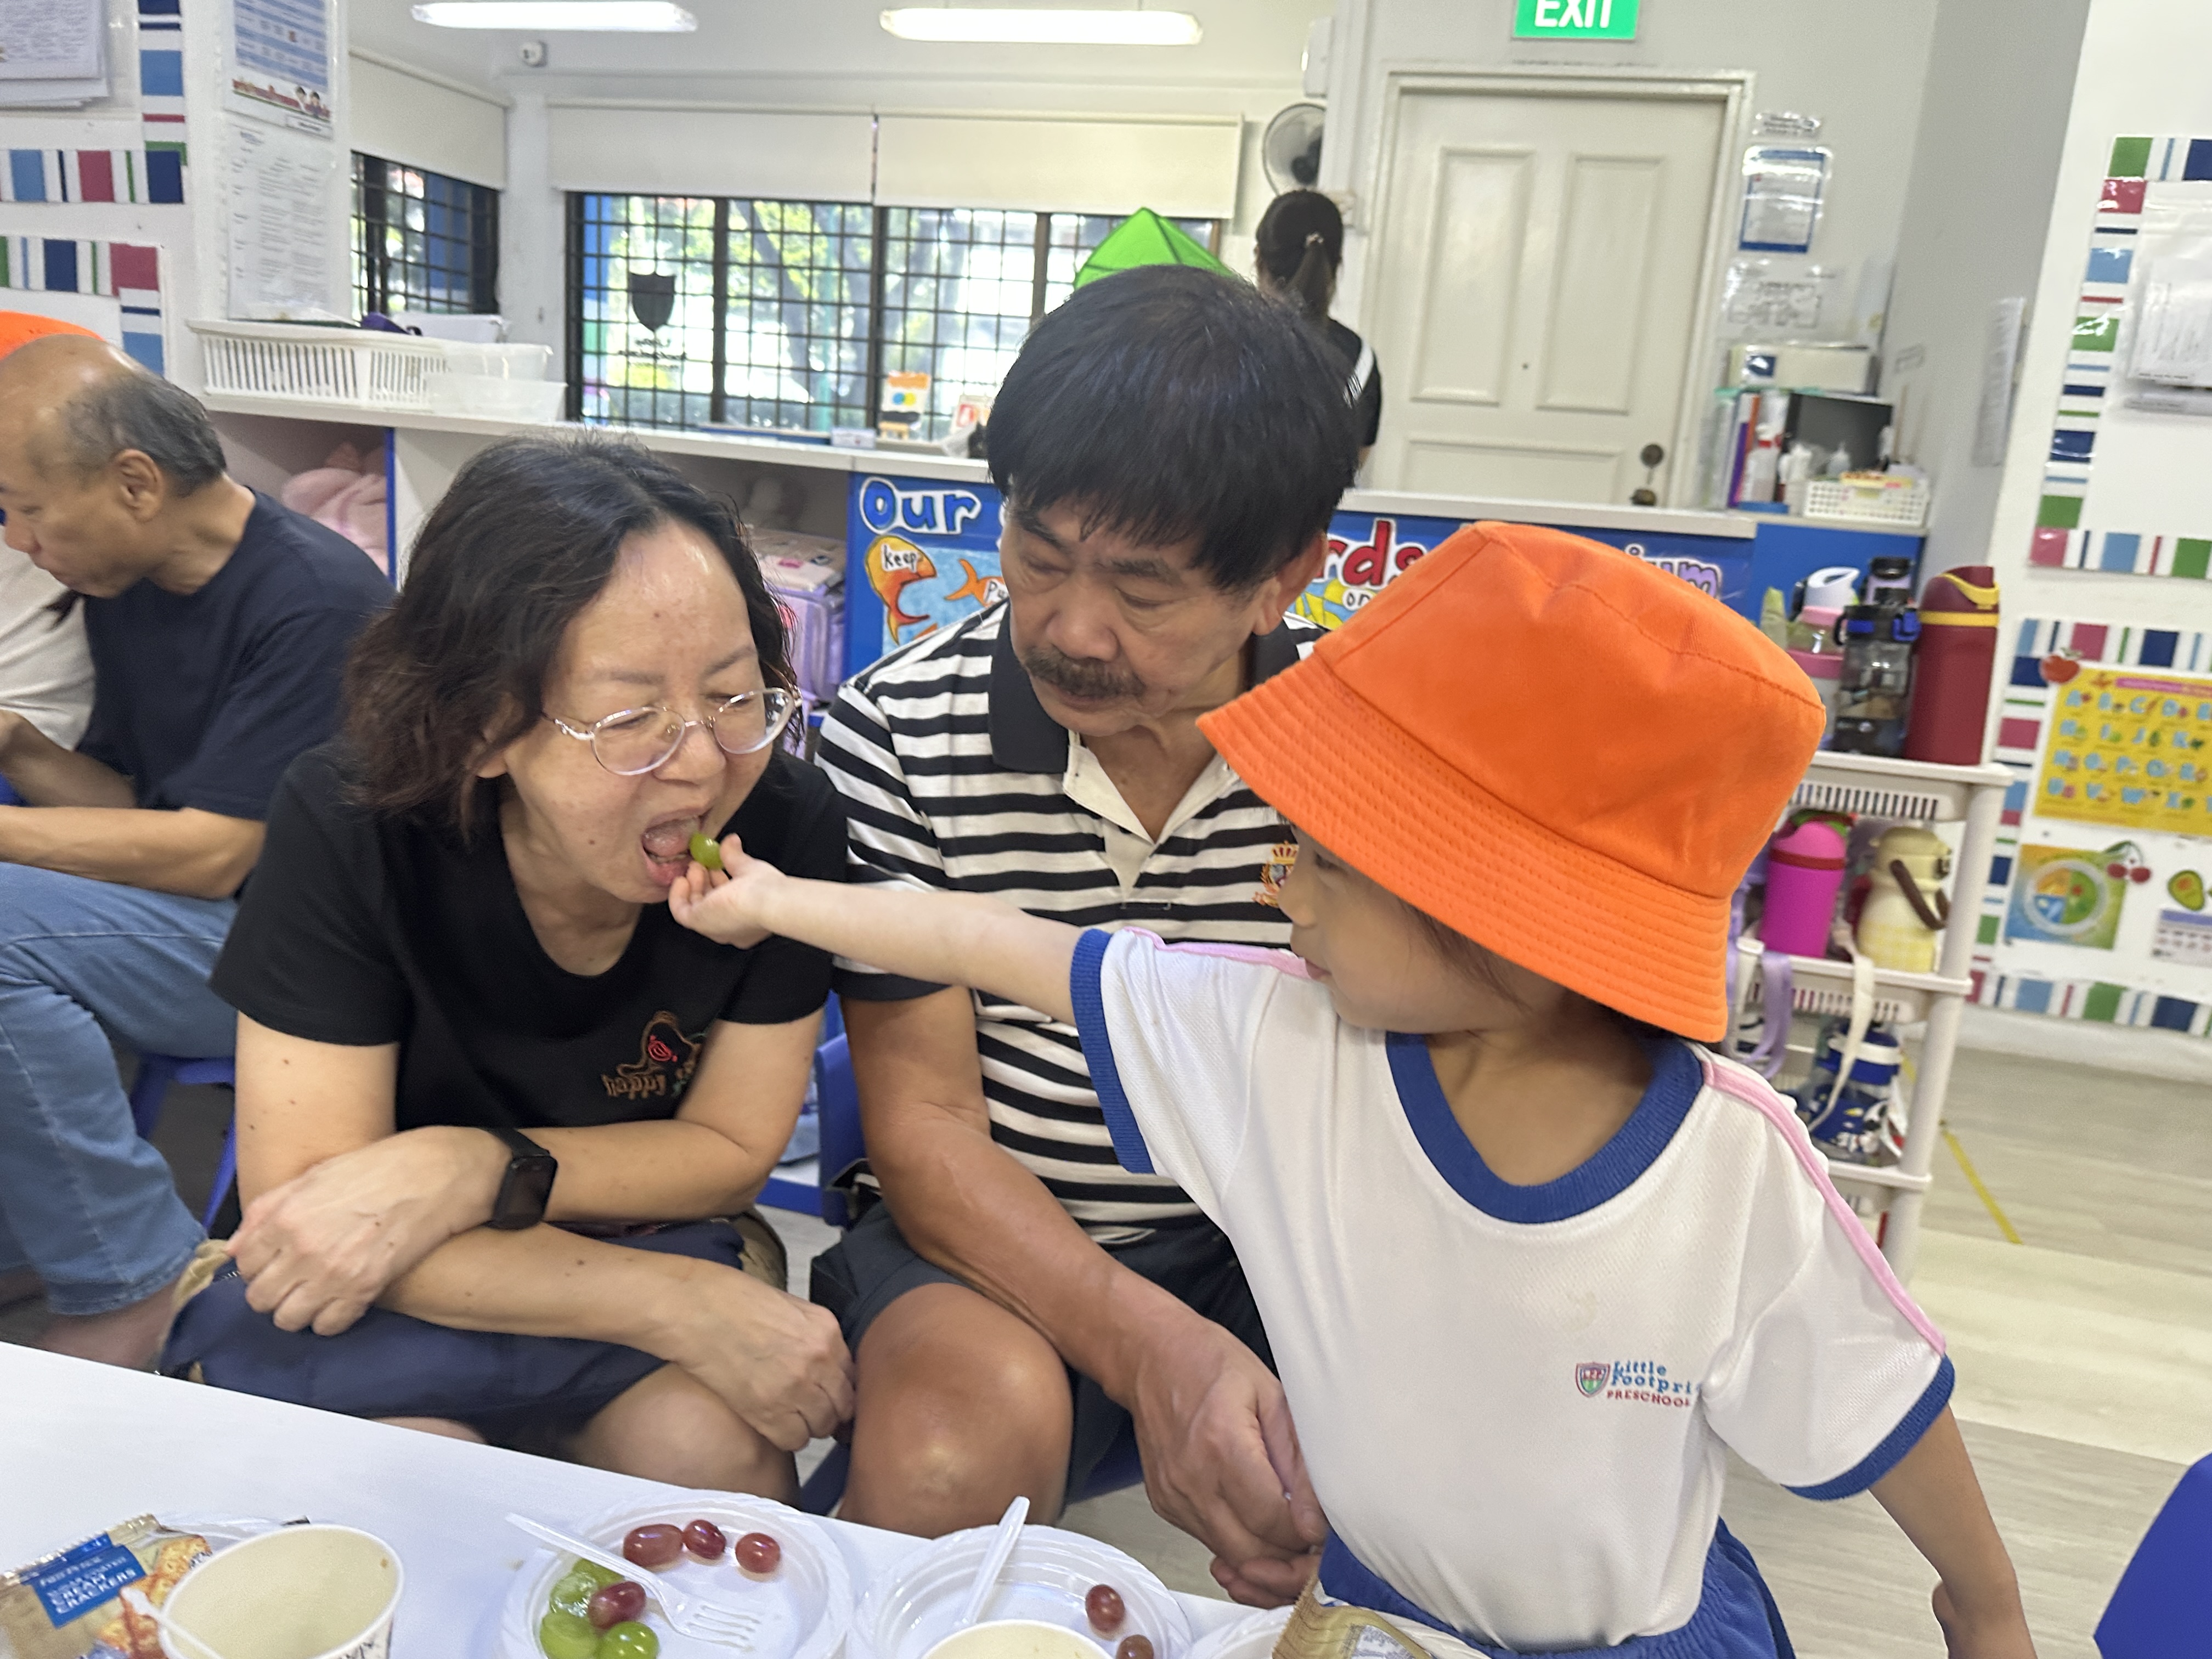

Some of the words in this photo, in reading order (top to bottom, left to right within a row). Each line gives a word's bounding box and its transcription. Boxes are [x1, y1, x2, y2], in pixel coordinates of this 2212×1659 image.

[861, 478, 980, 532] Our
[1613, 1361, 1667, 1376] Little
[54, 1567, 137, 1615] CRACKERS
